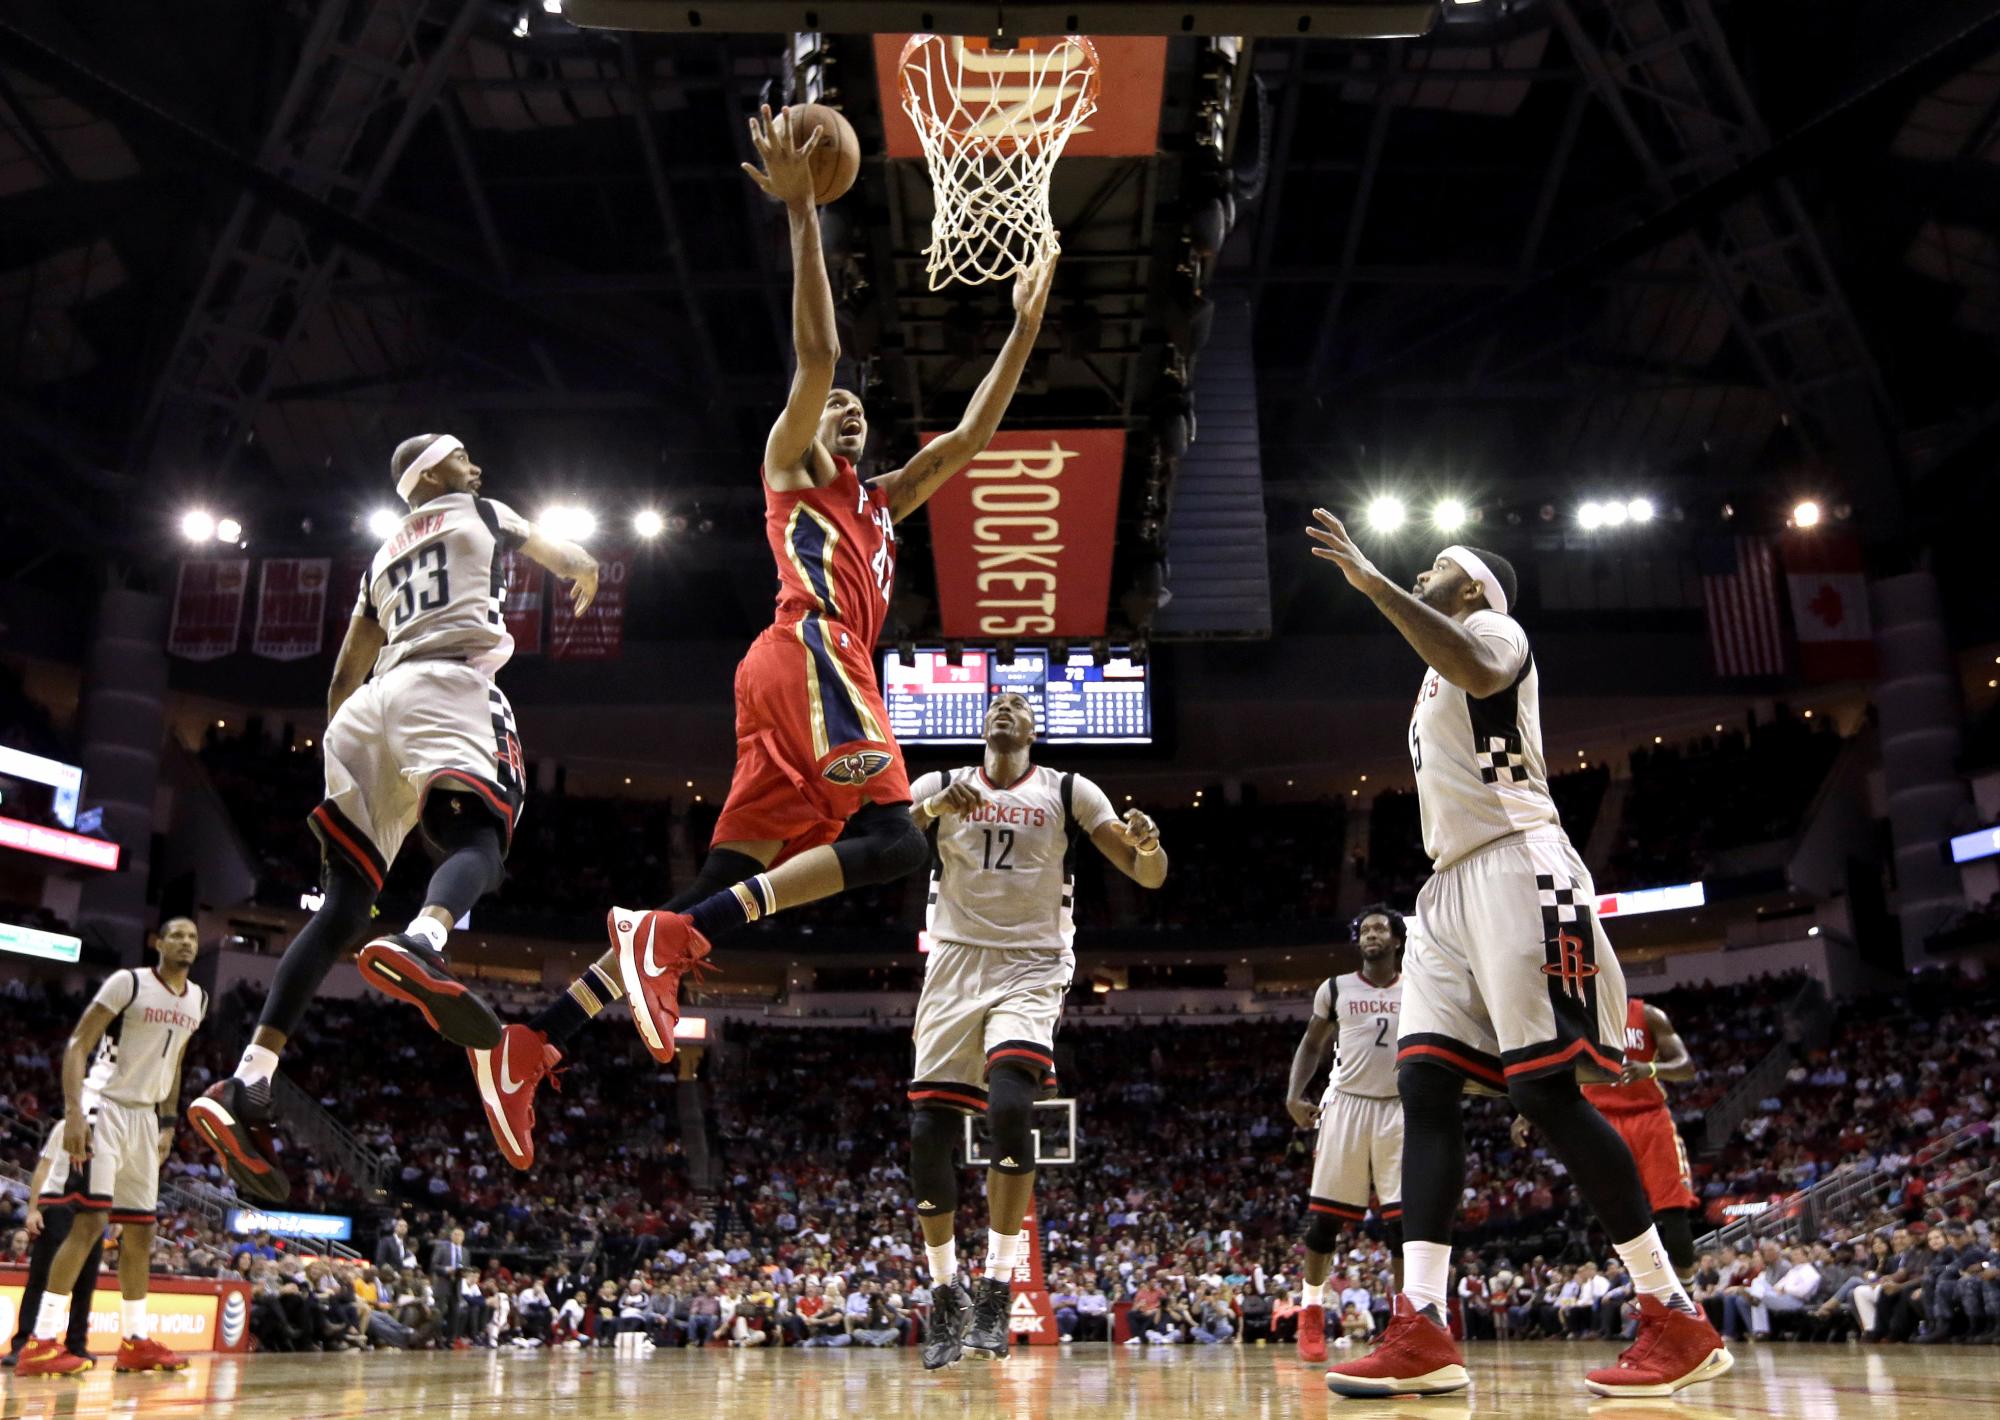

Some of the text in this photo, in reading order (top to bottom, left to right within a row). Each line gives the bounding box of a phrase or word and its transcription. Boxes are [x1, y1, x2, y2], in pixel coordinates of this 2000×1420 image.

[965, 440, 1080, 635] ROCKETS
[386, 541, 449, 626] 33
[1412, 720, 1422, 773] 5
[983, 828, 1014, 870] 12
[144, 1007, 198, 1033] ROCKETS
[1349, 1000, 1401, 1016] ROCKE
[161, 1028, 173, 1059] 1
[1375, 1017, 1388, 1048] 2
[1624, 1027, 1645, 1051] NS
[159, 1313, 205, 1334] WORLD
